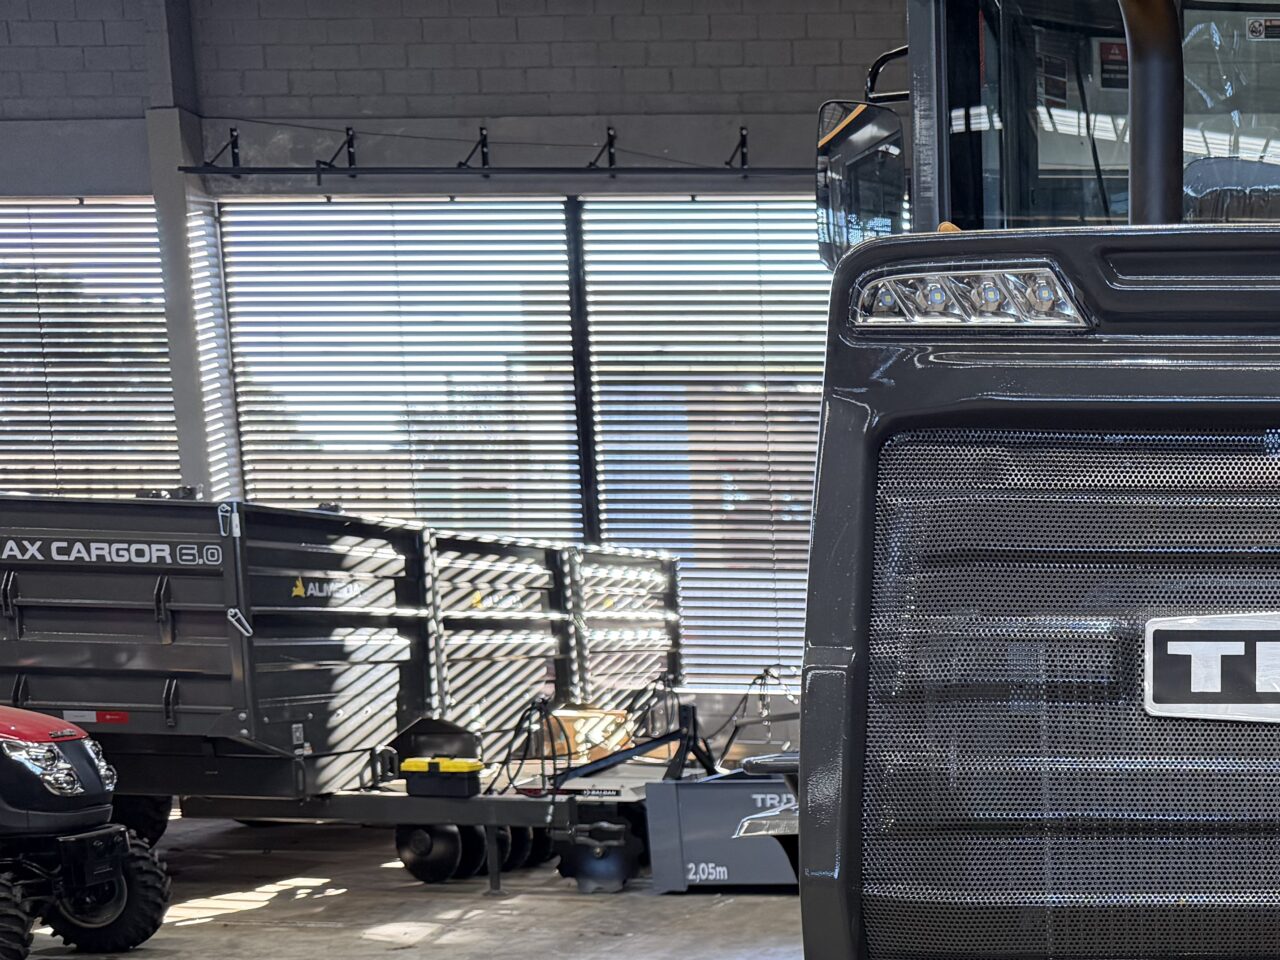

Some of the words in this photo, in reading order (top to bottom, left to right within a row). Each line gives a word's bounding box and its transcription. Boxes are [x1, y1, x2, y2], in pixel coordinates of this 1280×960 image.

[51, 541, 172, 563] CARGOR
[176, 544, 223, 565] 6.0
[687, 862, 728, 883] 2,05m
